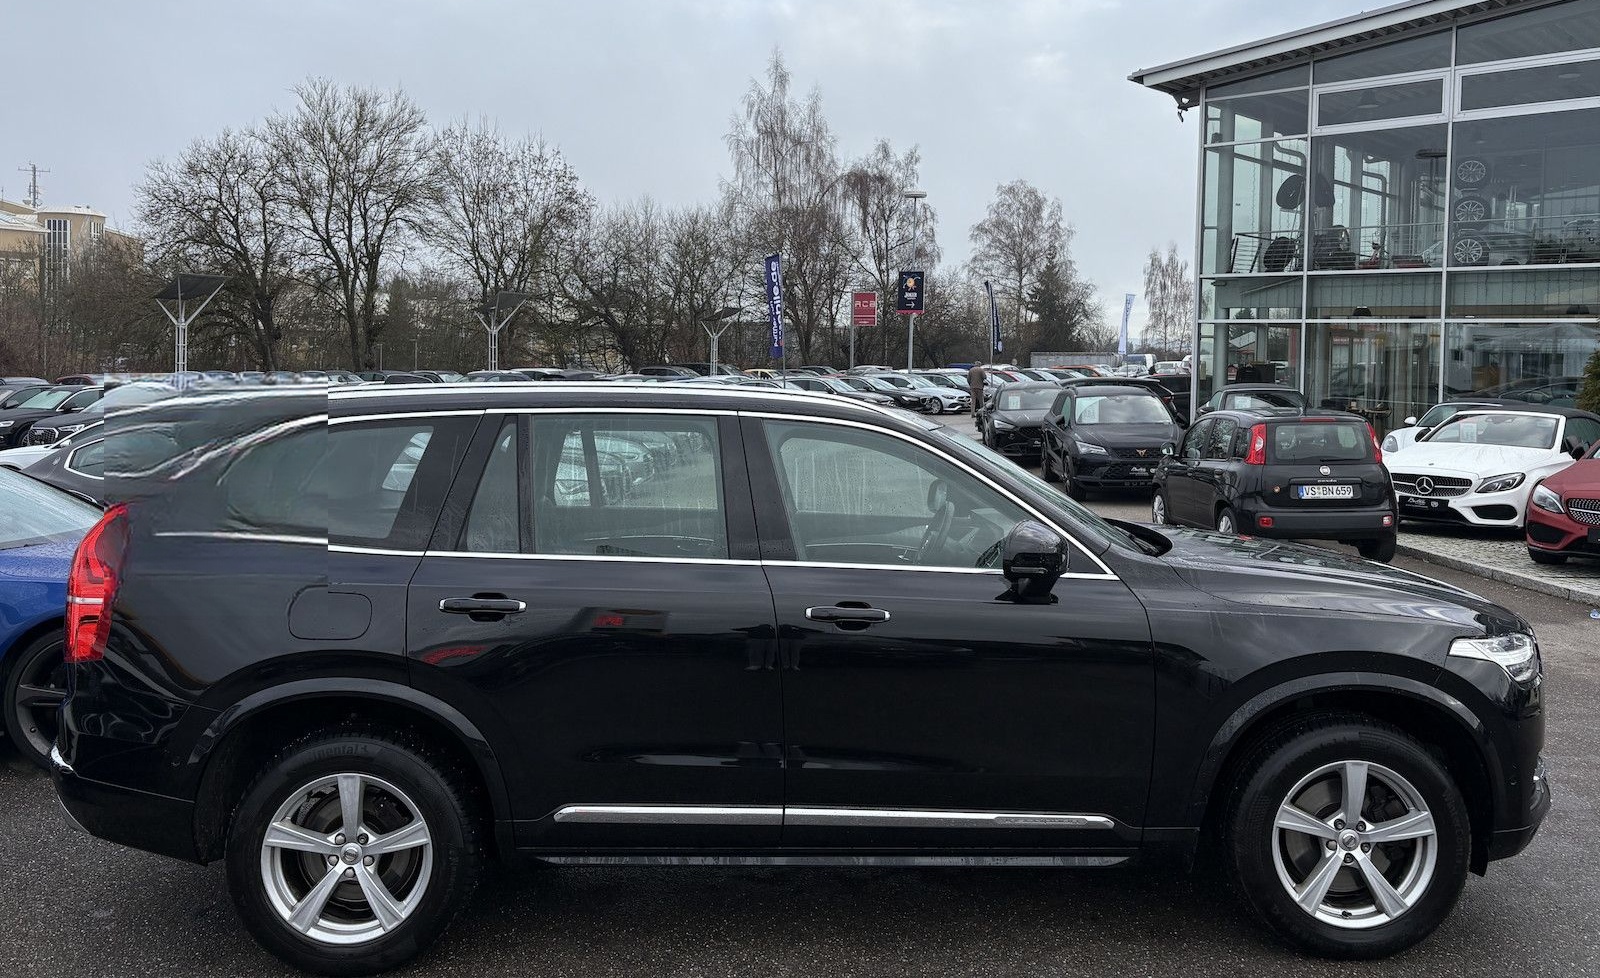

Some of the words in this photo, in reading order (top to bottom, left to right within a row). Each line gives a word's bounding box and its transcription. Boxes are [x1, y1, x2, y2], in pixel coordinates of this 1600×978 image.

[1304, 487, 1317, 496] VS
[1322, 487, 1335, 496] BN
[1335, 486, 1352, 496] 659
